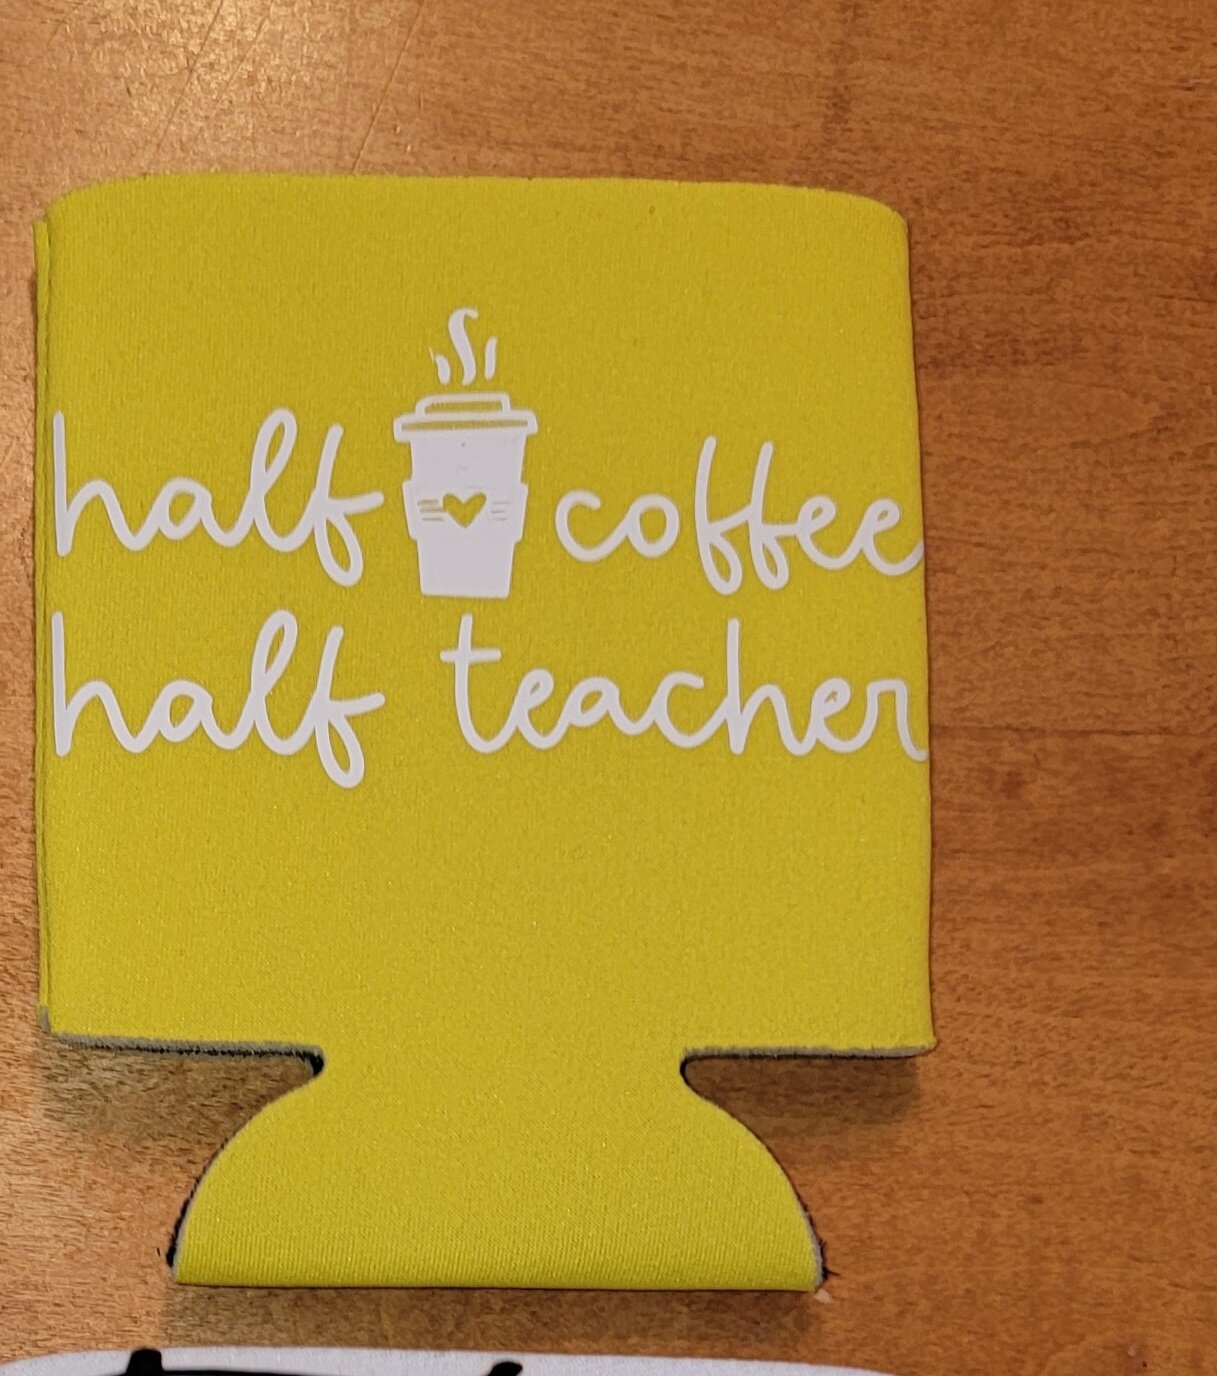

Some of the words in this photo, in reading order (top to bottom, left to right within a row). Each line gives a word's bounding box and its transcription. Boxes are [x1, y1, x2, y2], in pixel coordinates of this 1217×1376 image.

[52, 407, 384, 587] half
[555, 436, 925, 595] coffee
[52, 609, 385, 788] half
[440, 613, 928, 762] teacher
